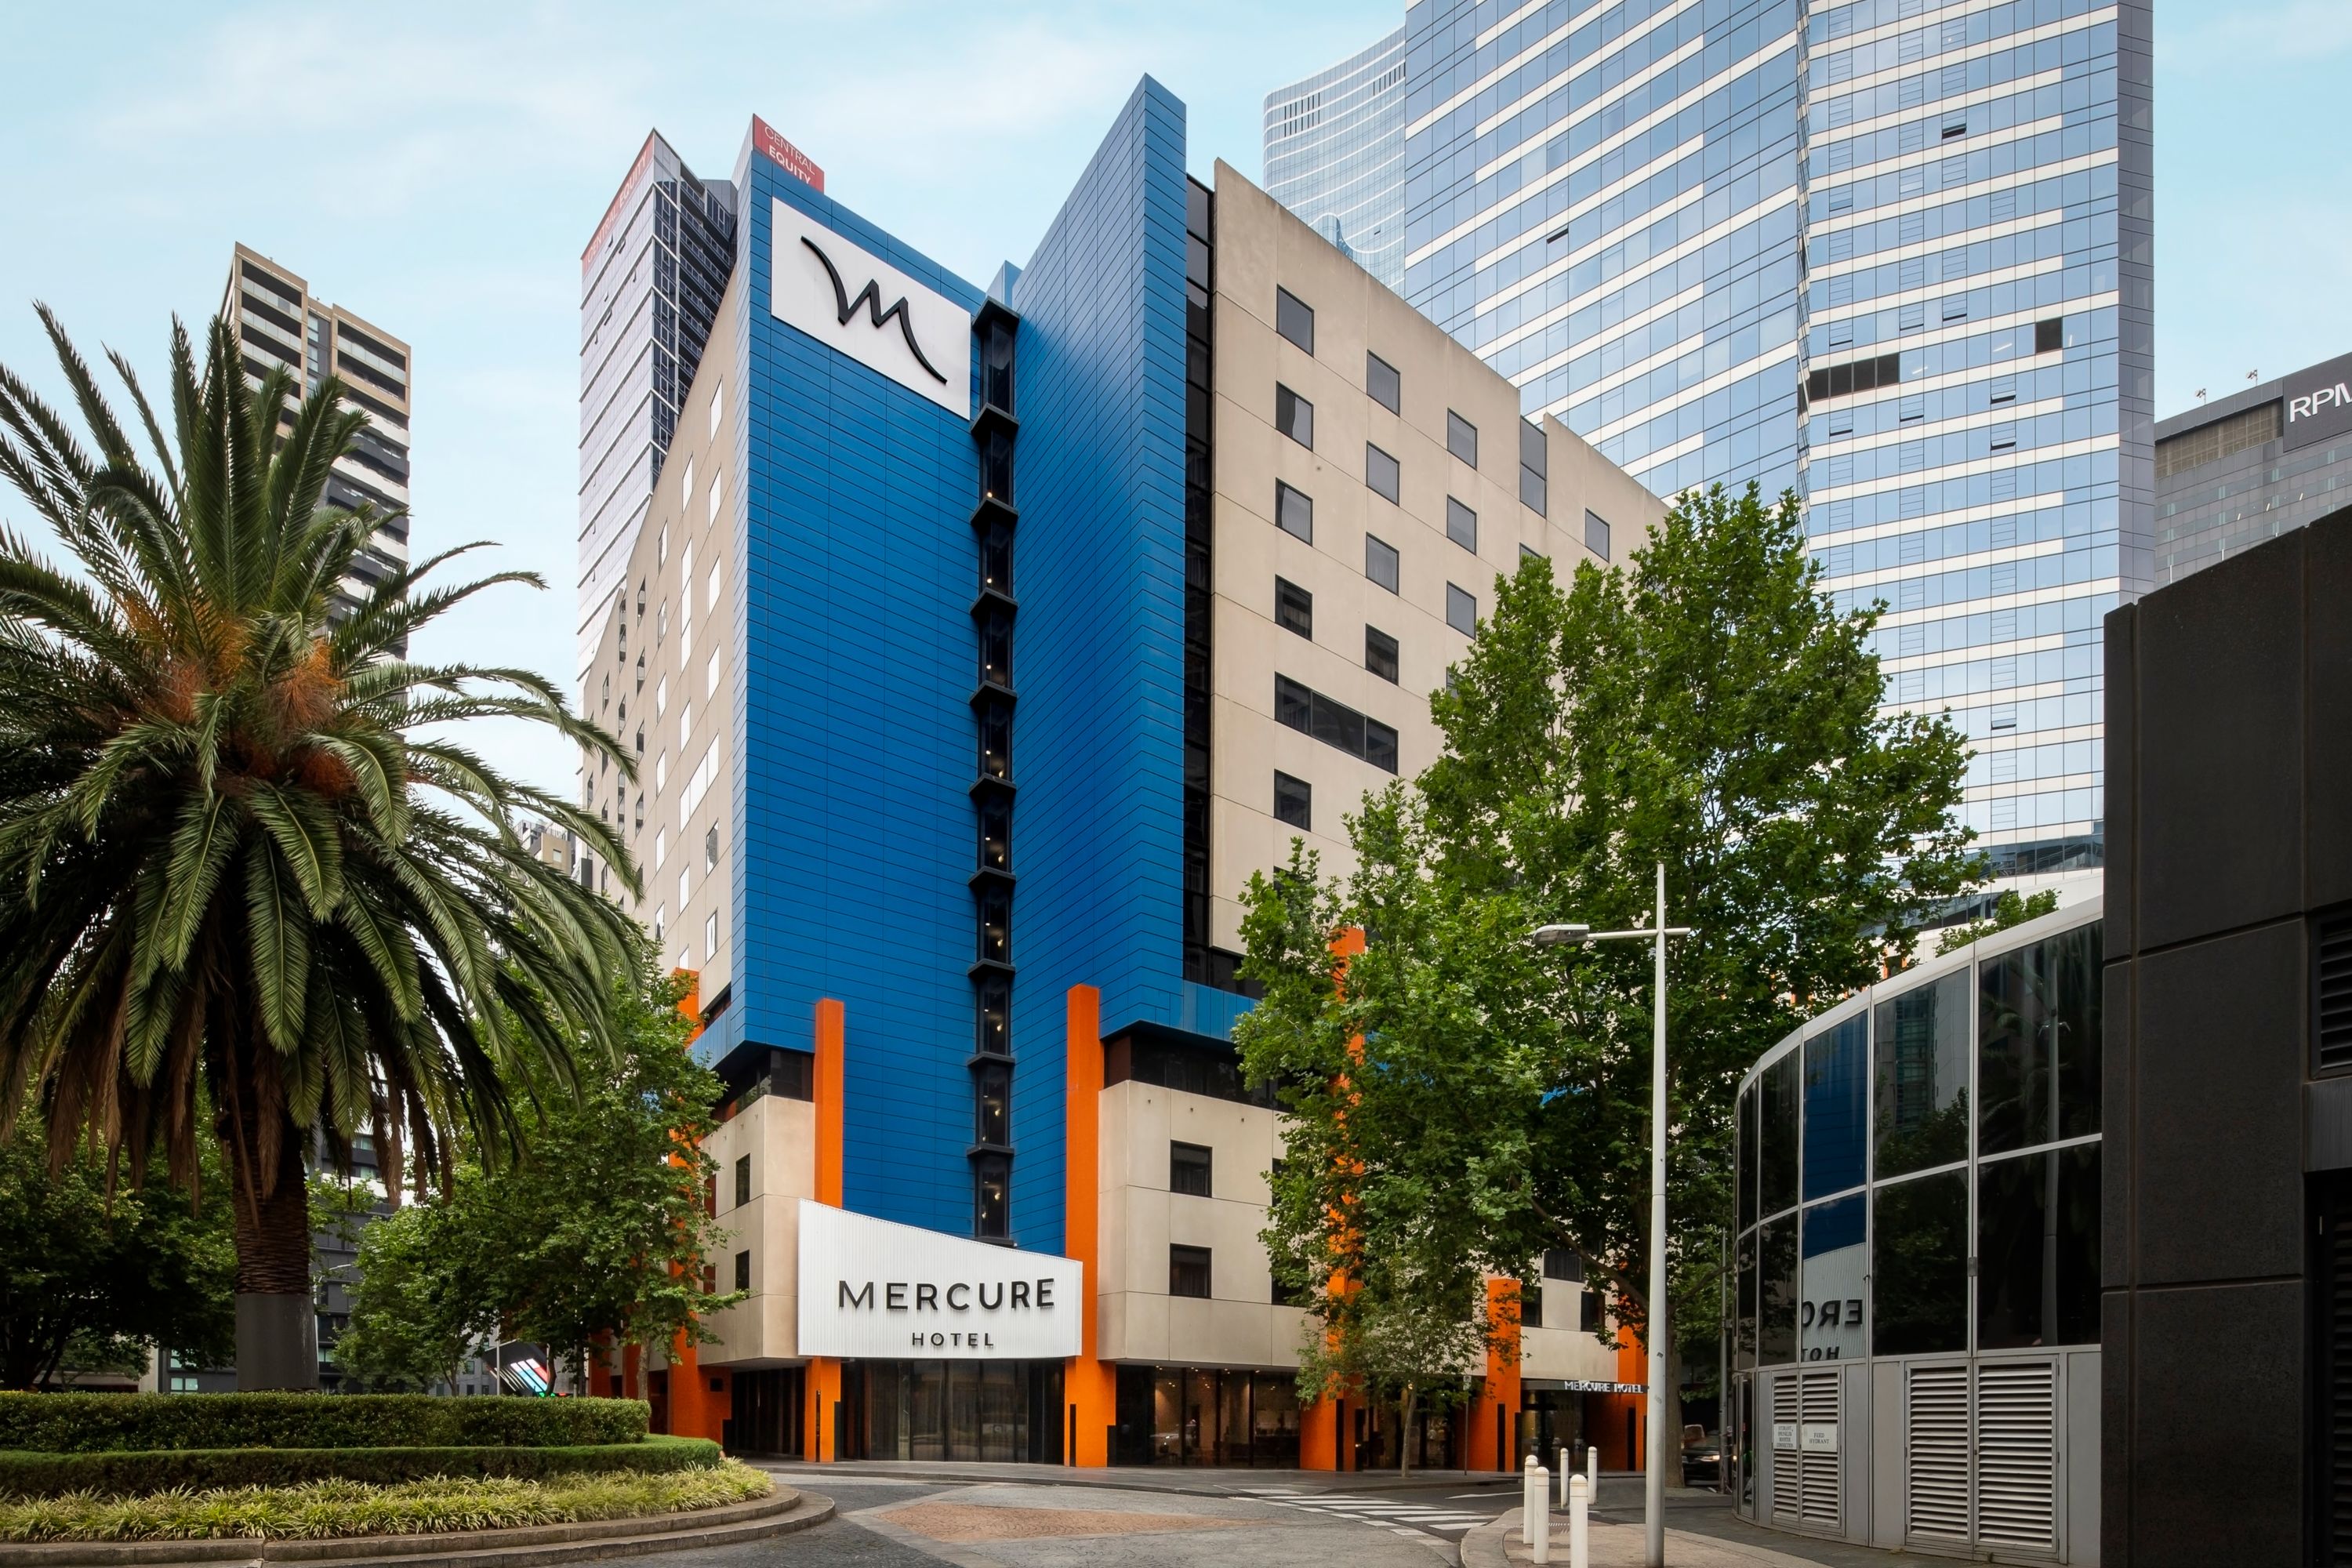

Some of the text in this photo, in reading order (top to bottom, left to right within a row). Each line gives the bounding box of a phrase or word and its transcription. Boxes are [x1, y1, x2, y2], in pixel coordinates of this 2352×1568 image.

[764, 125, 815, 175] CENTRAL
[768, 144, 811, 184] EQUITY
[587, 150, 647, 263] CENTRAL EQUITY
[838, 1277, 1055, 1312] MERCURE
[912, 1332, 995, 1347] HOTEL
[1564, 1380, 1644, 1394] MERCURE HOTEL
